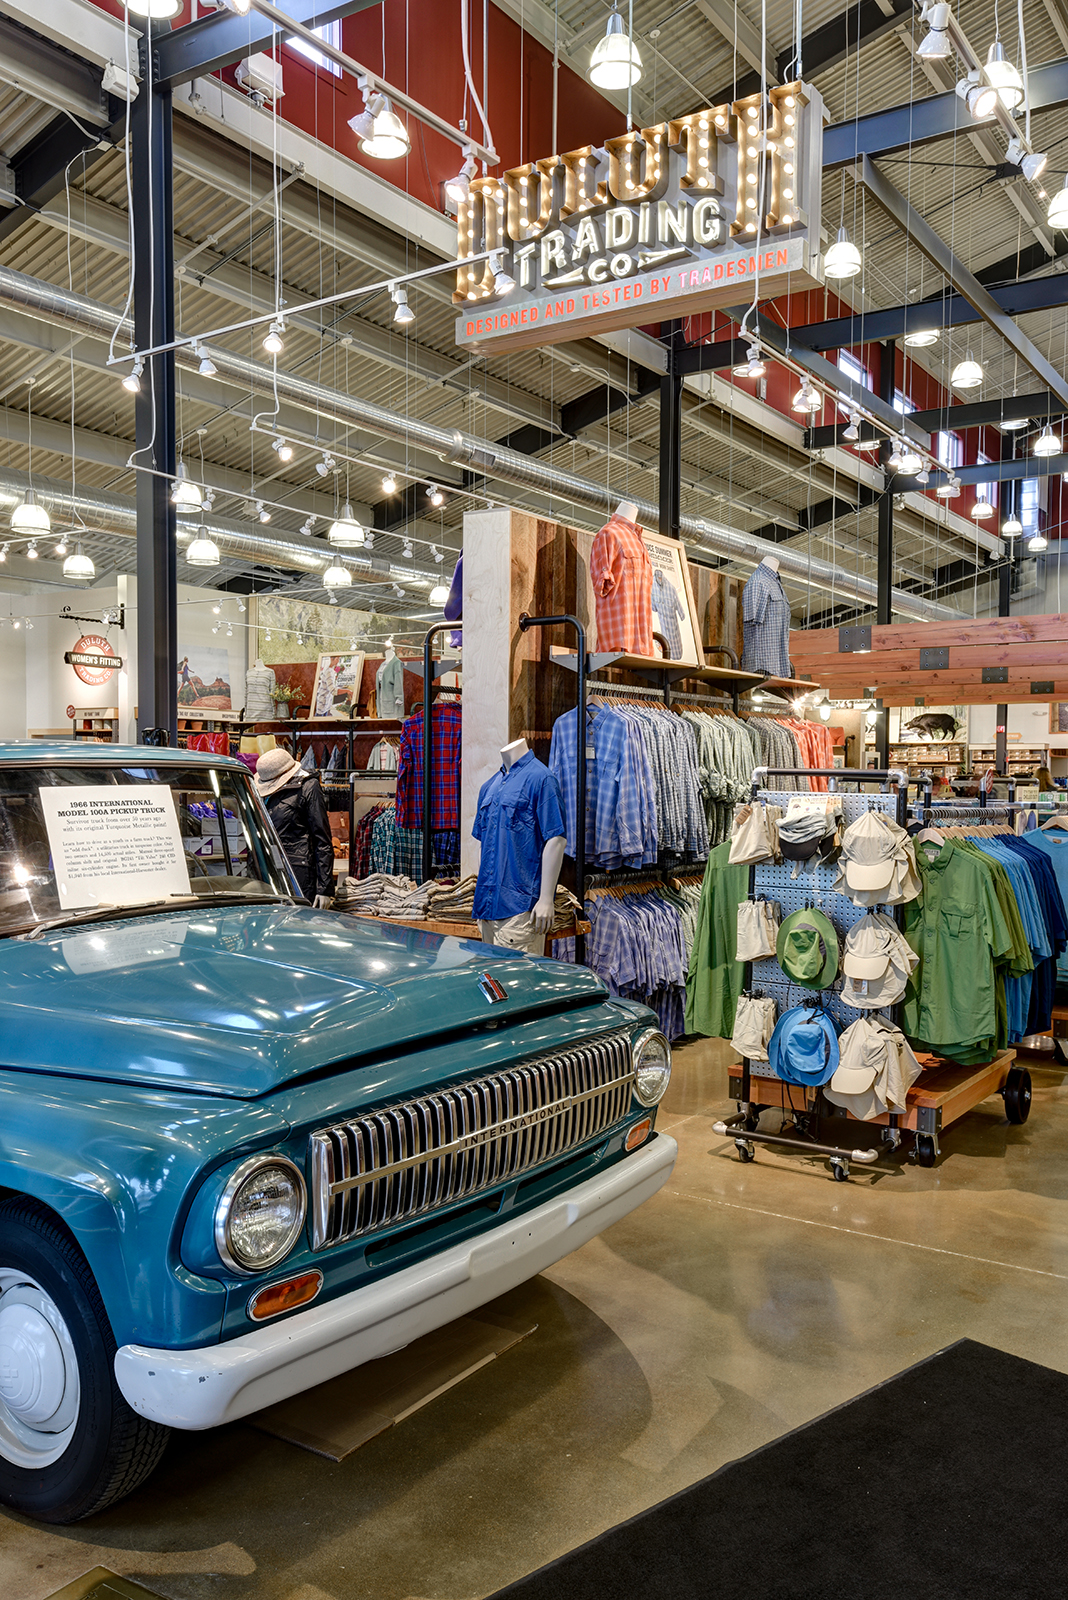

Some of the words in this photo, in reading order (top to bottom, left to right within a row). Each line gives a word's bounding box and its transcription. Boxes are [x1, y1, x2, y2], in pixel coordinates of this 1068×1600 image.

[452, 79, 808, 304] DULUTH
[513, 197, 722, 289] TRADING
[587, 252, 634, 283] CO
[466, 306, 539, 337] DESIGNED
[544, 297, 575, 319] AND
[582, 283, 643, 310] TESTED
[650, 275, 671, 295] BY
[678, 248, 788, 289] TRADESMEN
[71, 653, 98, 665] WOMEN'S
[99, 656, 121, 667] FITTING
[80, 637, 111, 652] DULUTH
[79, 666, 104, 684] TRADING
[465, 1102, 567, 1147] INTERNATIONAL
